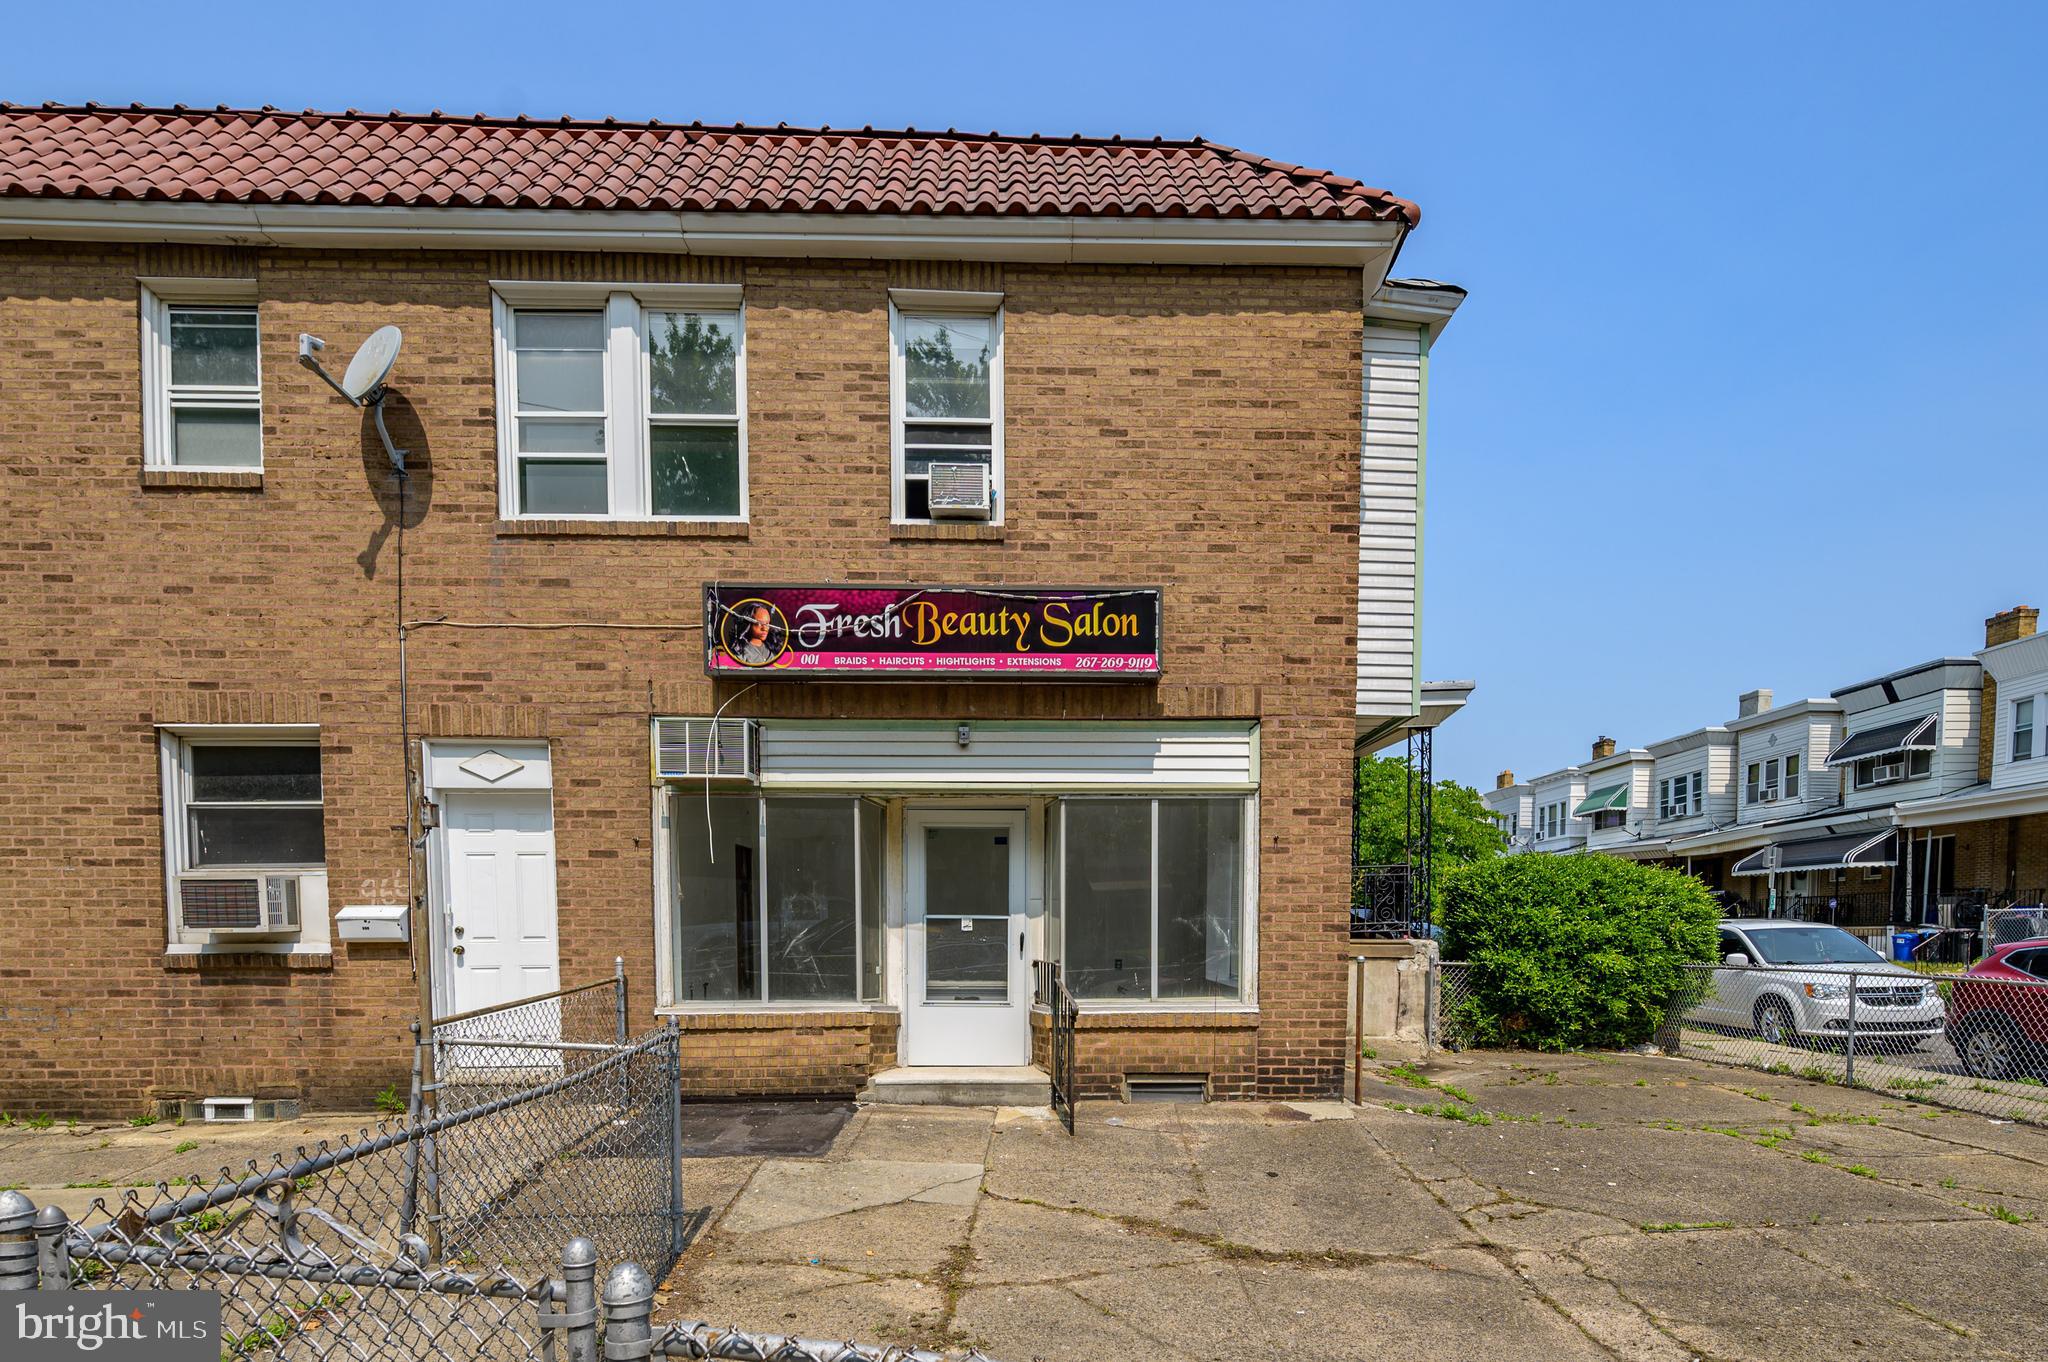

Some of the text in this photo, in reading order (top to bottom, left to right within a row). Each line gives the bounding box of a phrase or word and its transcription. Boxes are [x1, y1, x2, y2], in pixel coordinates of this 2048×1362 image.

[796, 601, 1139, 651] Fresh Beauty Salon
[801, 654, 820, 665] 001
[834, 656, 1062, 666] BRAIDS HAIRCUTS HIGHTLIGHTS EXTENSIONS
[1075, 656, 1153, 668] 267-269-9119
